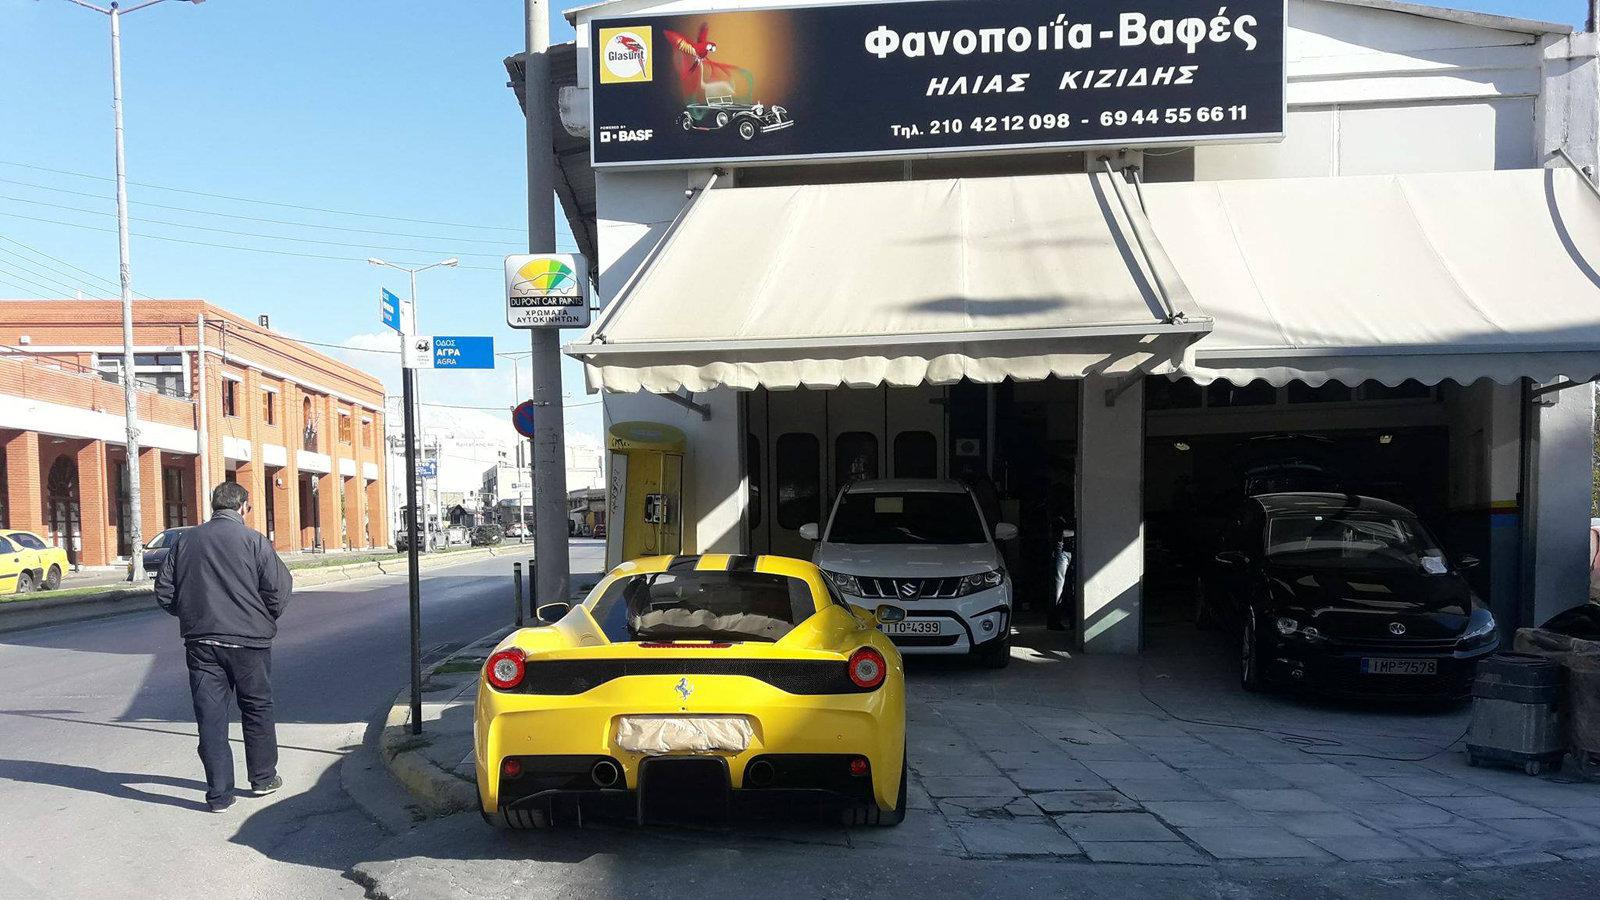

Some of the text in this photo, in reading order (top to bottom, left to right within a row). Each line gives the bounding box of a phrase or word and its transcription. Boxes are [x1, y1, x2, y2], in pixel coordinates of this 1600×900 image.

[608, 51, 645, 61] Glasurit
[926, 65, 1199, 96] ΗΛΙΑΣ ΚΙΖΙΔΗΣ
[891, 124, 924, 139] Τηλ.
[930, 119, 963, 135] 210
[1028, 113, 1071, 130] 098
[618, 129, 654, 142] BASF
[541, 297, 557, 306] CAR
[559, 296, 583, 305] PAINTS
[525, 309, 568, 317] ΧΡΩΜΑΤΑ
[436, 349, 460, 357] ΑΓΡΑ
